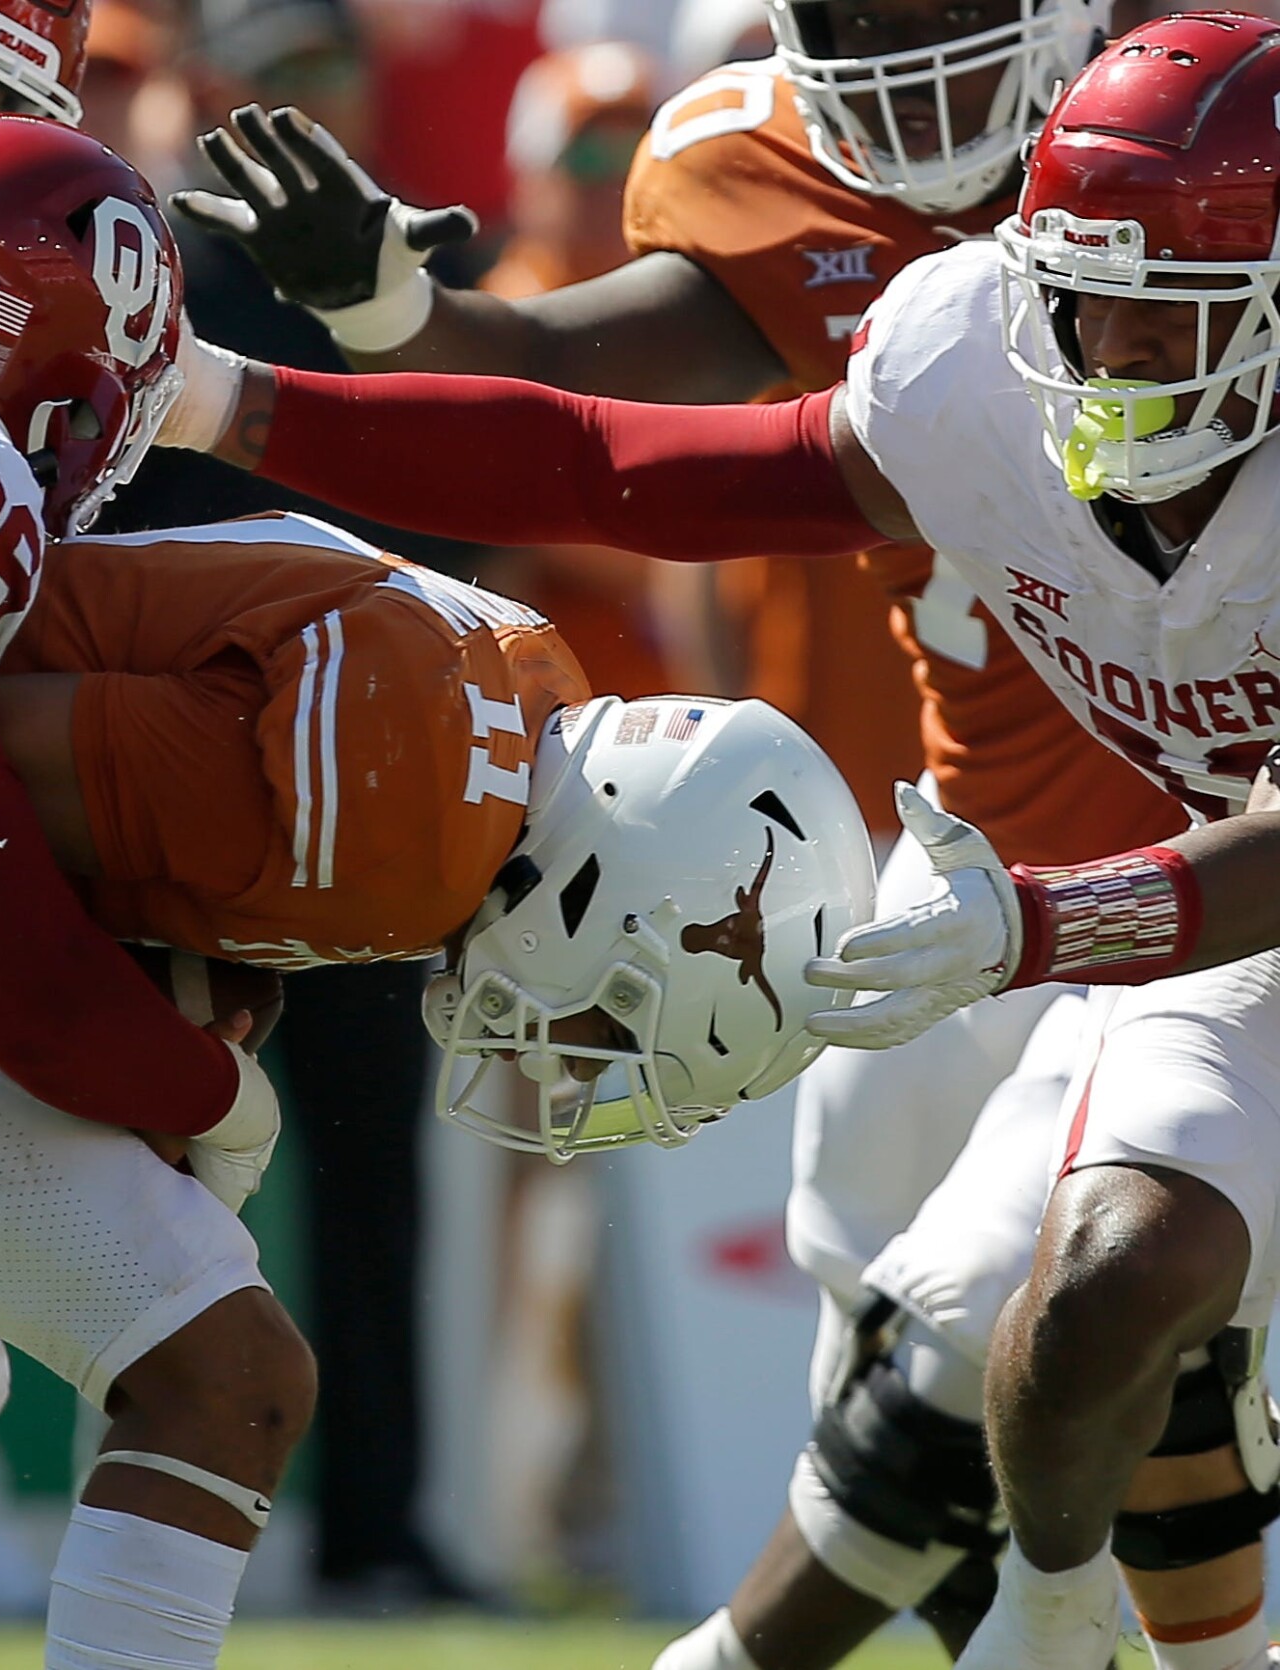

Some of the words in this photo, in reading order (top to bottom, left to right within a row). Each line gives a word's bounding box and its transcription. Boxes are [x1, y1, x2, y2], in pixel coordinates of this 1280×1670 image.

[93, 196, 170, 369] OU
[1004, 566, 1070, 622] XII
[463, 682, 529, 806] 11
